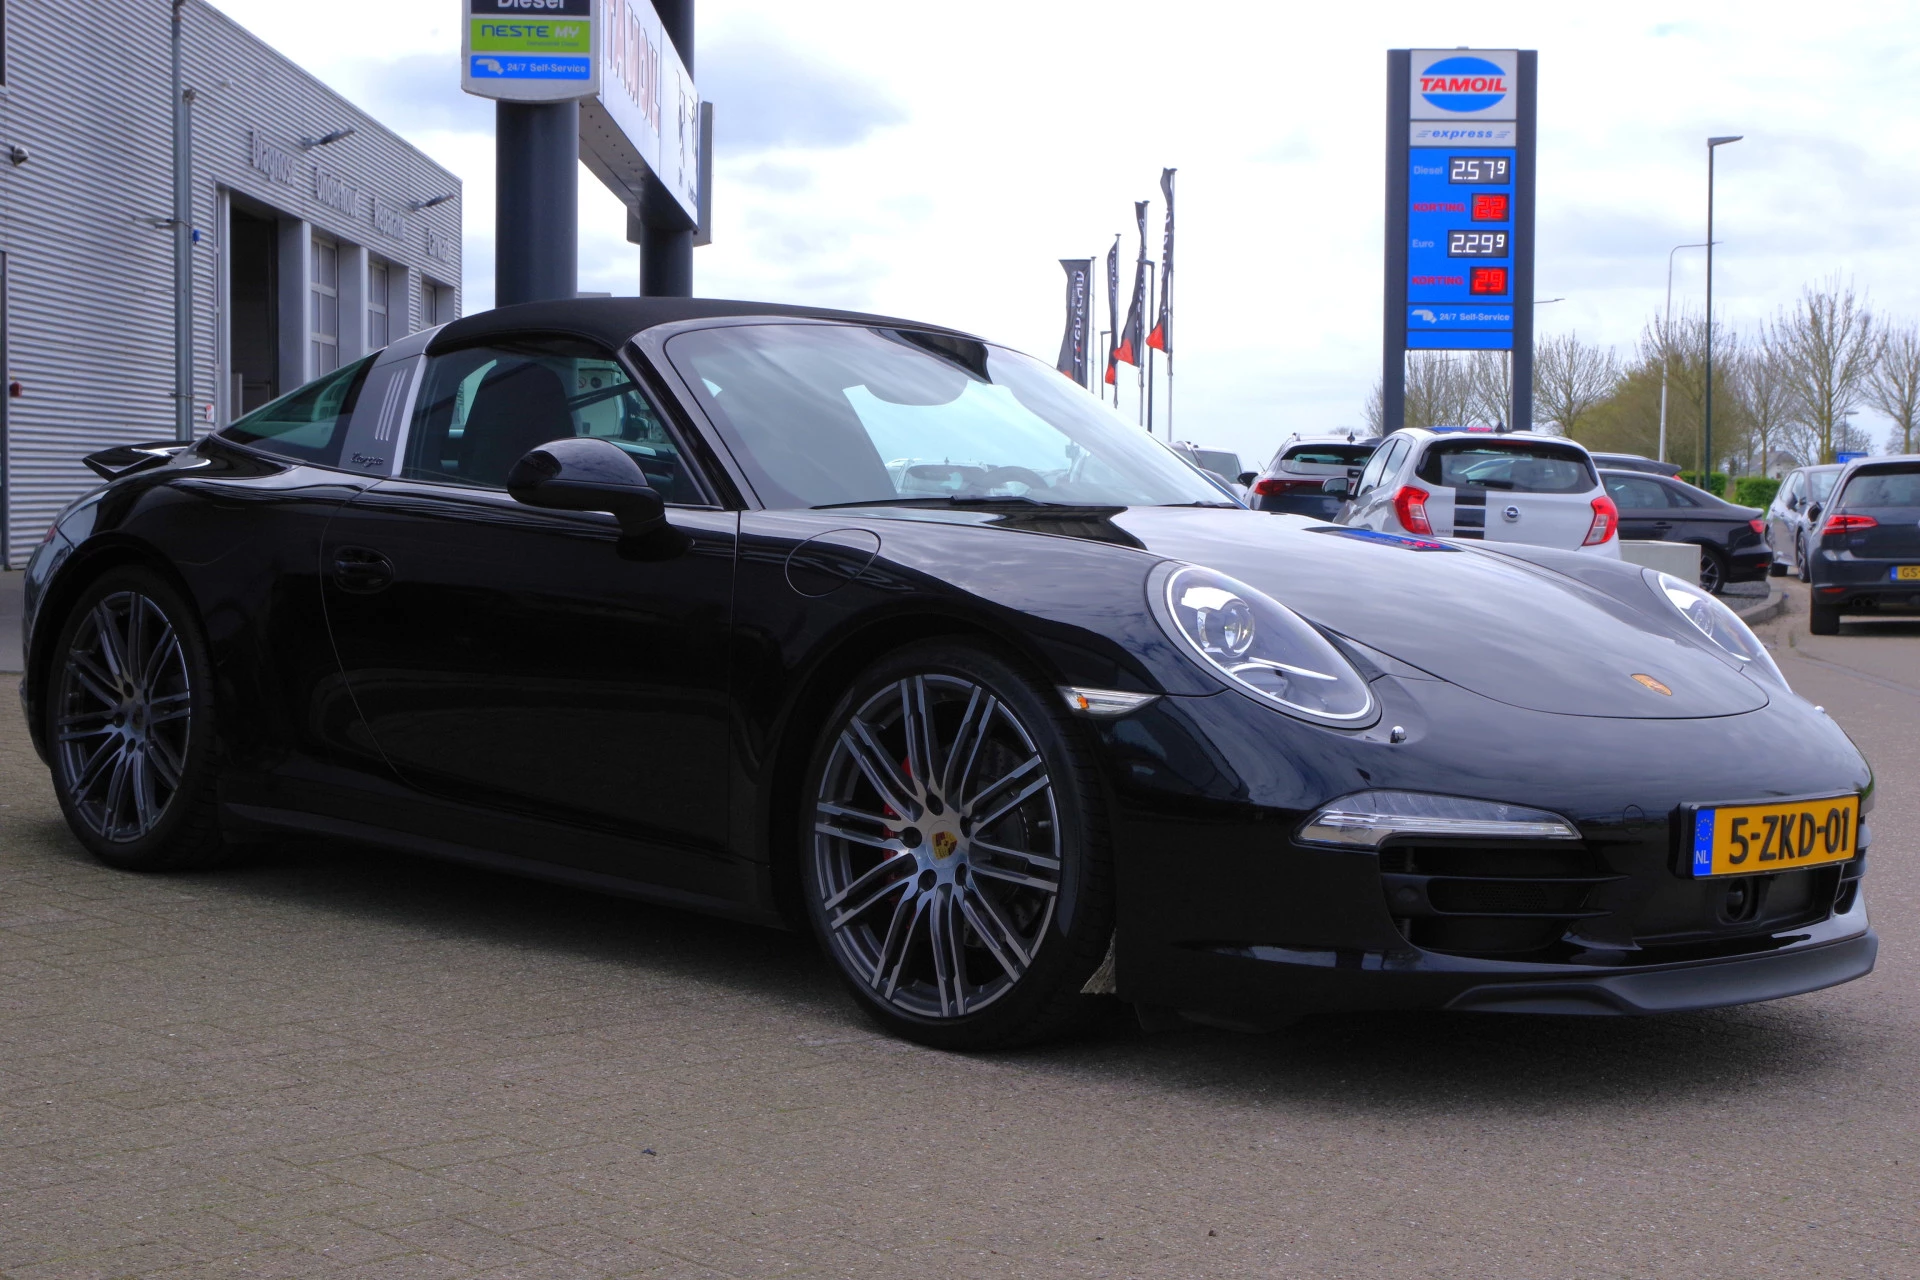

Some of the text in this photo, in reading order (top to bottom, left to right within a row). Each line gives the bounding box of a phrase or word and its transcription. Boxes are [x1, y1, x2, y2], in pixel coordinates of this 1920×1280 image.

[554, 26, 579, 38] MY
[507, 63, 586, 73] 24/7 Self-Service
[1420, 78, 1507, 92] TAMOIL
[1432, 130, 1493, 140] express
[1413, 166, 1443, 175] Diesel
[1413, 203, 1465, 212] KORTING
[1412, 239, 1434, 248] Euro
[1412, 276, 1464, 285] KORTING
[1439, 313, 1510, 321] 24/7 Self-Service
[1729, 807, 1850, 865] 5-ZKD-01
[1695, 850, 1710, 864] NL
